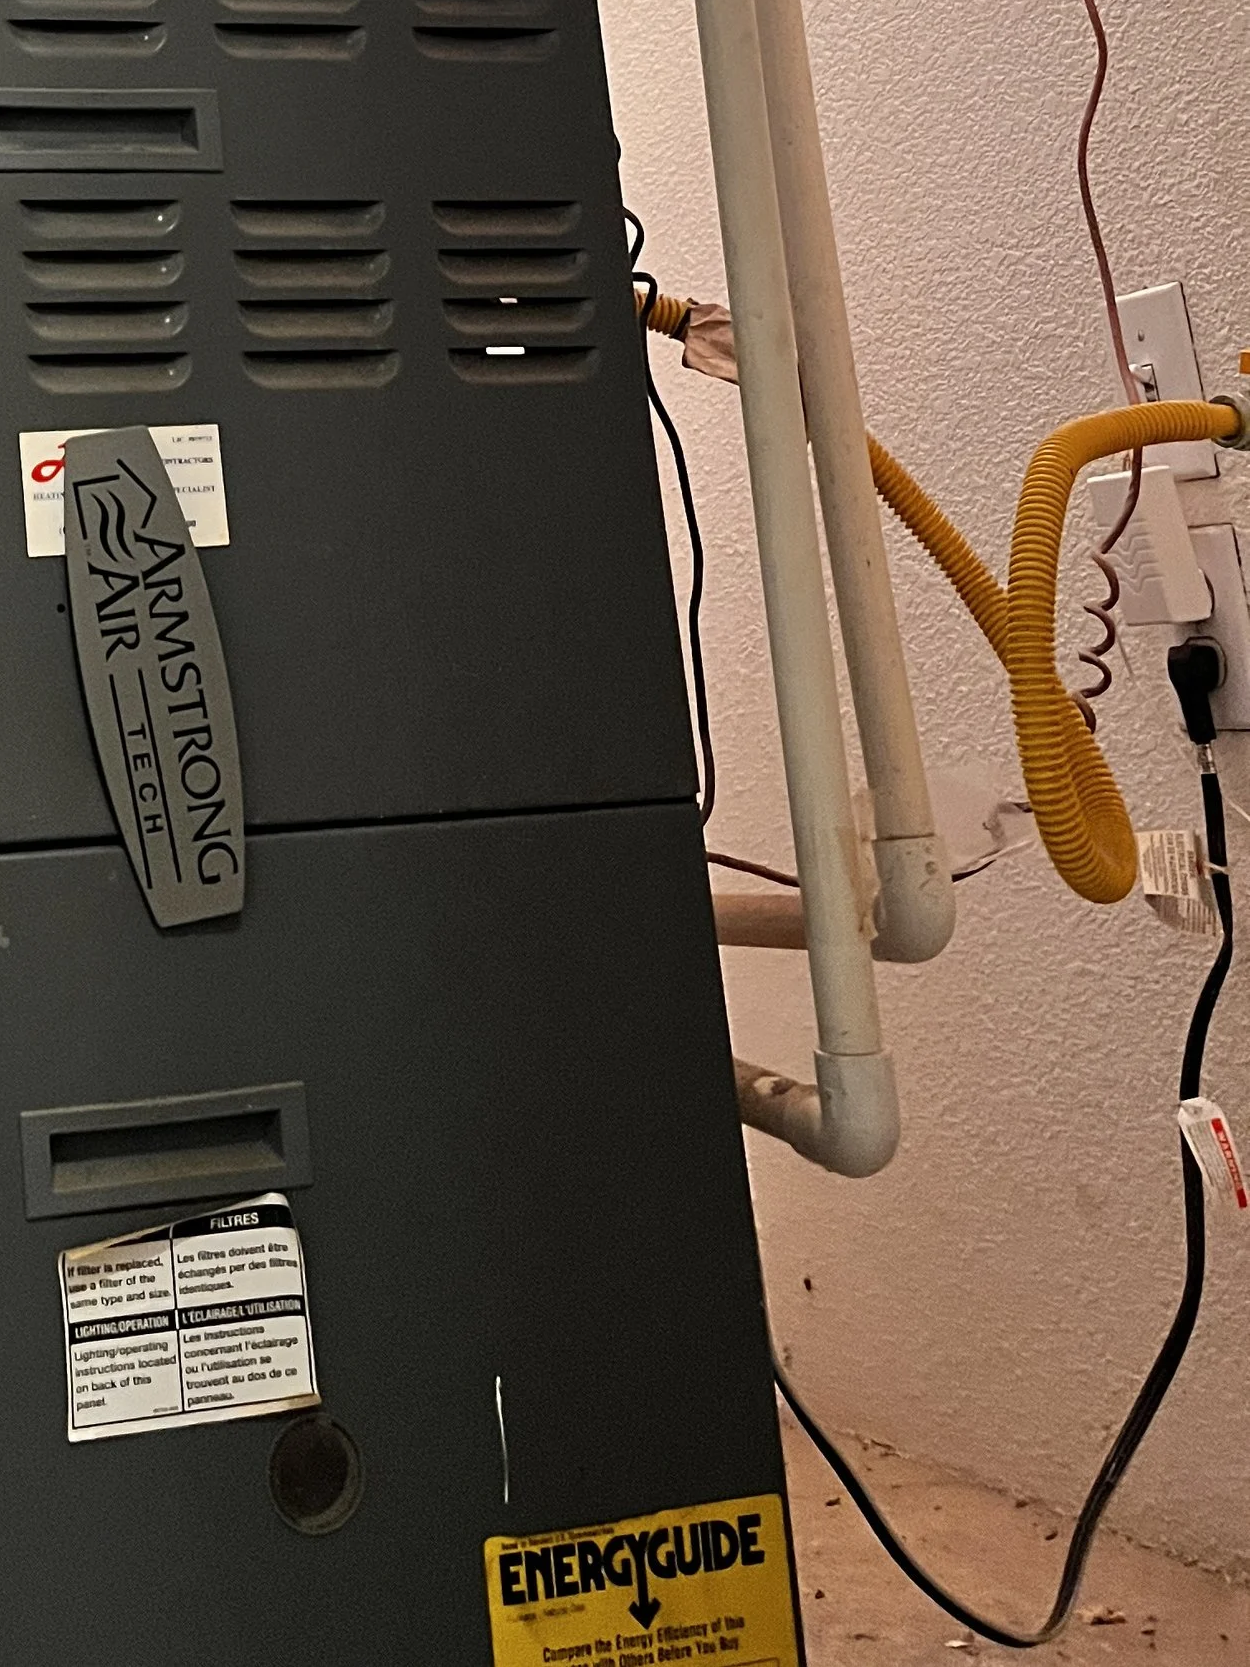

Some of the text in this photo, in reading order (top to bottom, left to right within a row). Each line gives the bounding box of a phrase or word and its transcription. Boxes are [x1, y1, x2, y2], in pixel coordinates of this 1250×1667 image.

[88, 561, 141, 663] AIR
[133, 528, 240, 886] ARMSTRONG
[126, 721, 165, 835] TECH
[210, 1212, 259, 1229] FILTRES
[177, 1254, 195, 1263] Les
[198, 1250, 226, 1261] filtres
[229, 1244, 265, 1257] doivent
[249, 1260, 266, 1270] des
[90, 1282, 96, 1290] a
[99, 1278, 123, 1288] filter
[126, 1275, 136, 1286] of
[140, 1274, 155, 1284] the
[70, 1298, 97, 1309] same
[101, 1295, 123, 1306] type
[126, 1290, 145, 1301] and
[183, 1334, 201, 1344] Les
[74, 1341, 169, 1363] Lighting/operating
[184, 1342, 243, 1359] concernant
[75, 1354, 177, 1378] instructions located
[185, 1365, 199, 1375] ou
[260, 1355, 272, 1365] se
[76, 1376, 152, 1394] on back of this
[186, 1367, 298, 1390] trouvent au dos de ce
[499, 1513, 766, 1612] ENERGYGUIDE
[542, 1615, 746, 1663] Compare the Energy Efficiency of this
[618, 1652, 655, 1667] Others
[657, 1644, 693, 1663] Before
[694, 1640, 717, 1655] You
[719, 1635, 740, 1651] Buy
